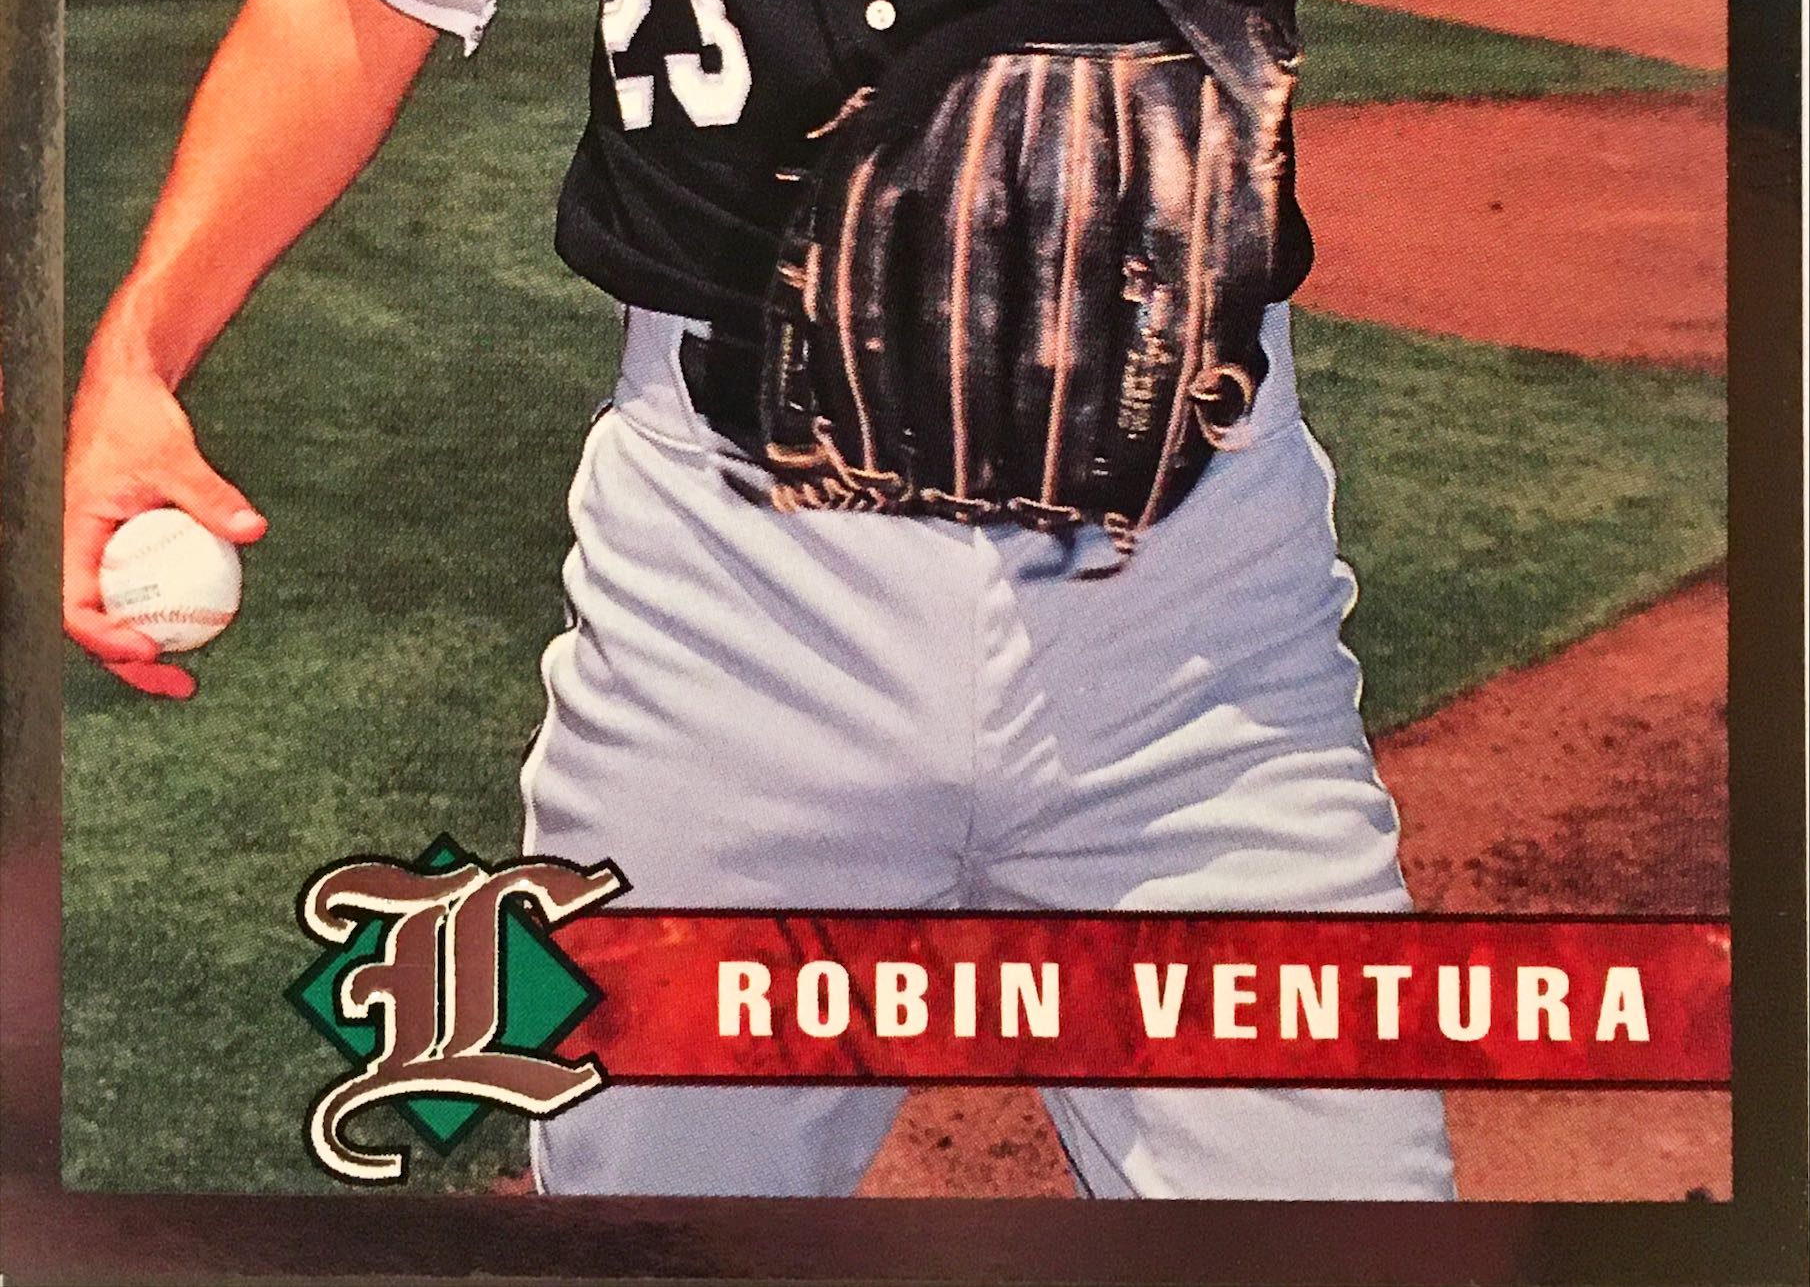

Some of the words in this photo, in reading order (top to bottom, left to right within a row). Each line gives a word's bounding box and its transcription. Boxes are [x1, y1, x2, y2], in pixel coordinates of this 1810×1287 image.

[295, 855, 631, 1186] L
[716, 960, 1062, 1040] ROBIN
[1132, 961, 1653, 1044] VENTURA
